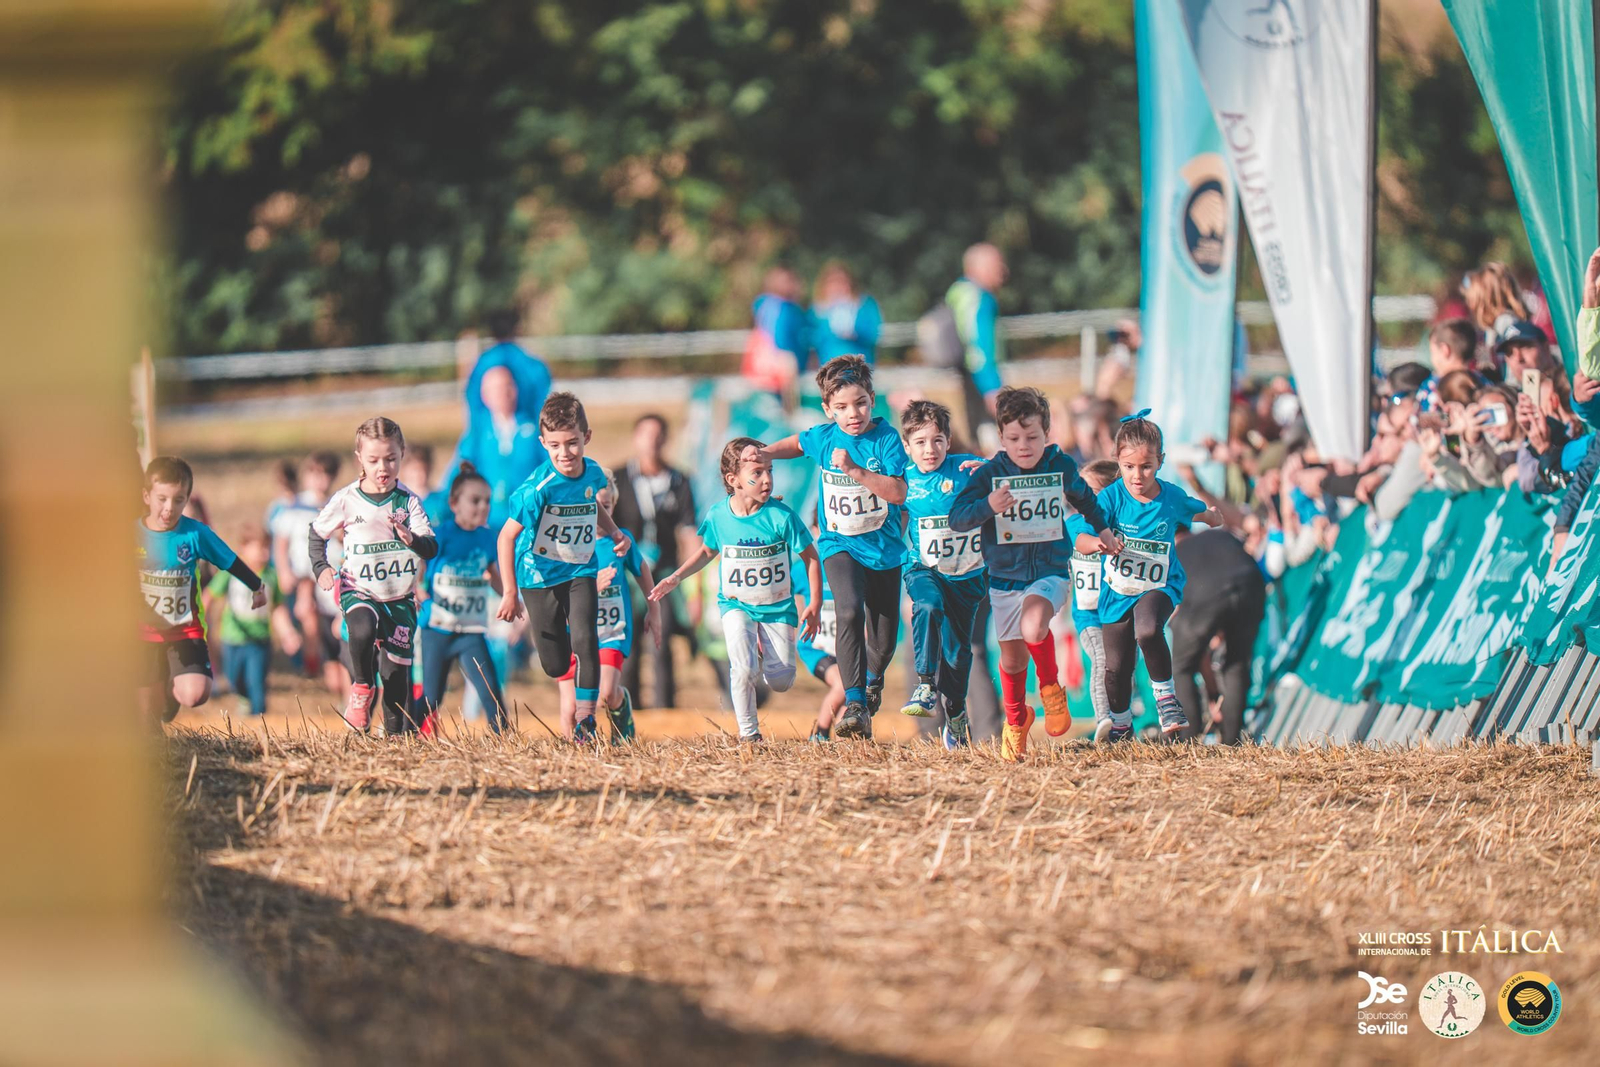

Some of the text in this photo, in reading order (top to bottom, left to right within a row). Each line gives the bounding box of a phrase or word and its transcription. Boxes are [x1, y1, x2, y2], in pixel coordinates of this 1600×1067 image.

[1014, 477, 1048, 488] ITÁLICA
[829, 493, 882, 516] 4611
[1002, 497, 1060, 521] 4646
[544, 524, 594, 545] 4578
[927, 533, 981, 559] 4576
[359, 557, 418, 582] 4644
[728, 562, 786, 587] 4695
[1109, 554, 1164, 583] 4610
[1075, 570, 1099, 591] 61
[149, 594, 187, 615] 736
[438, 596, 486, 615] 4670
